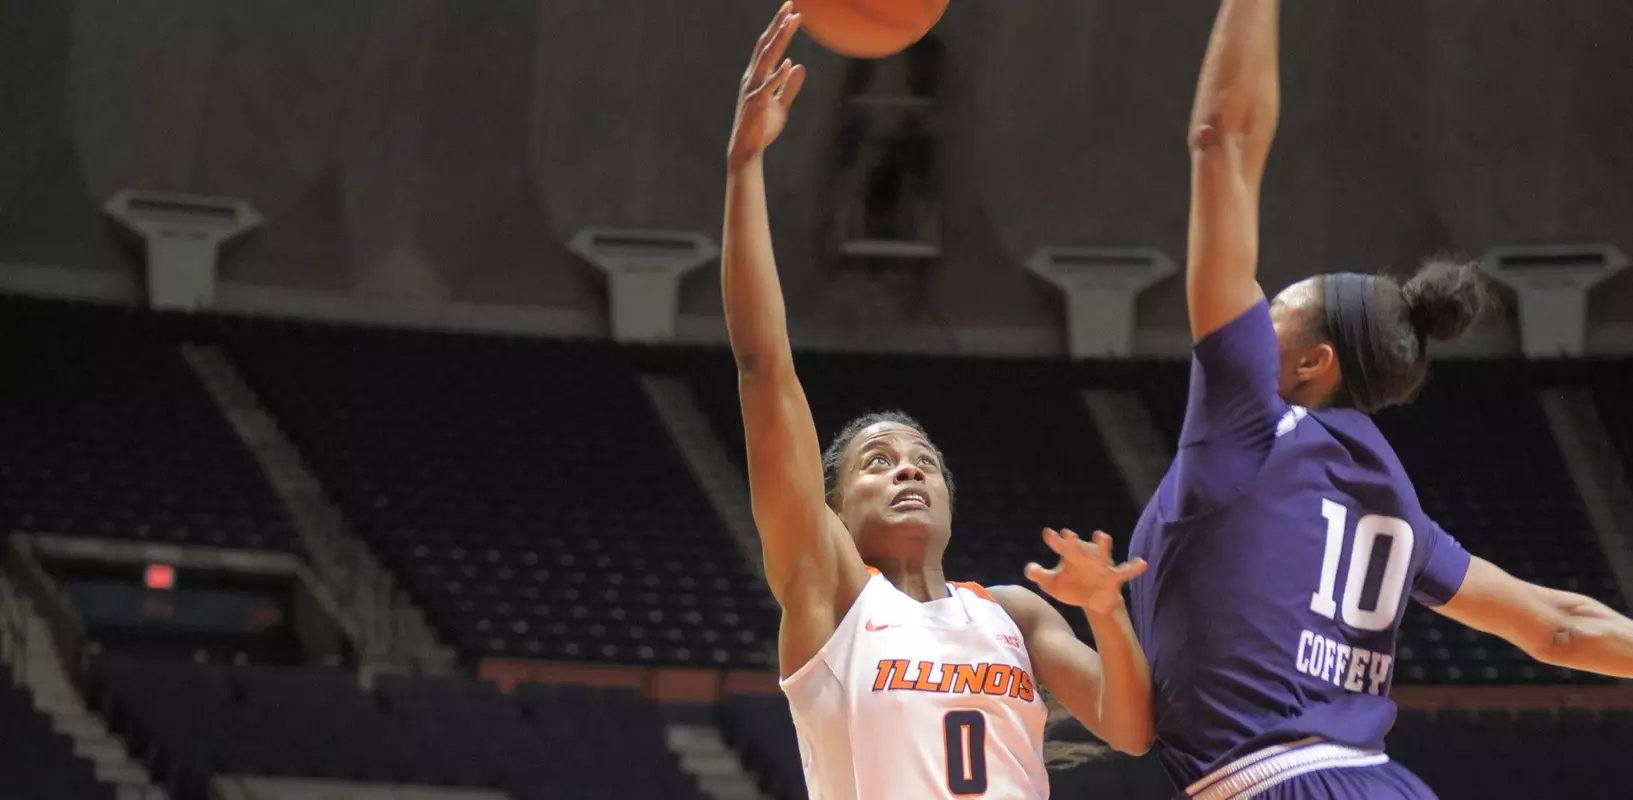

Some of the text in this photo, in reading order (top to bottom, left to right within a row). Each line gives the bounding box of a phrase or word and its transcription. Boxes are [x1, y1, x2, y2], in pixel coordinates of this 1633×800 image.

[1310, 497, 1414, 631] 10
[872, 659, 1035, 702] ILLINOIS
[1296, 629, 1391, 696] COFFEY
[942, 708, 988, 798] 0
